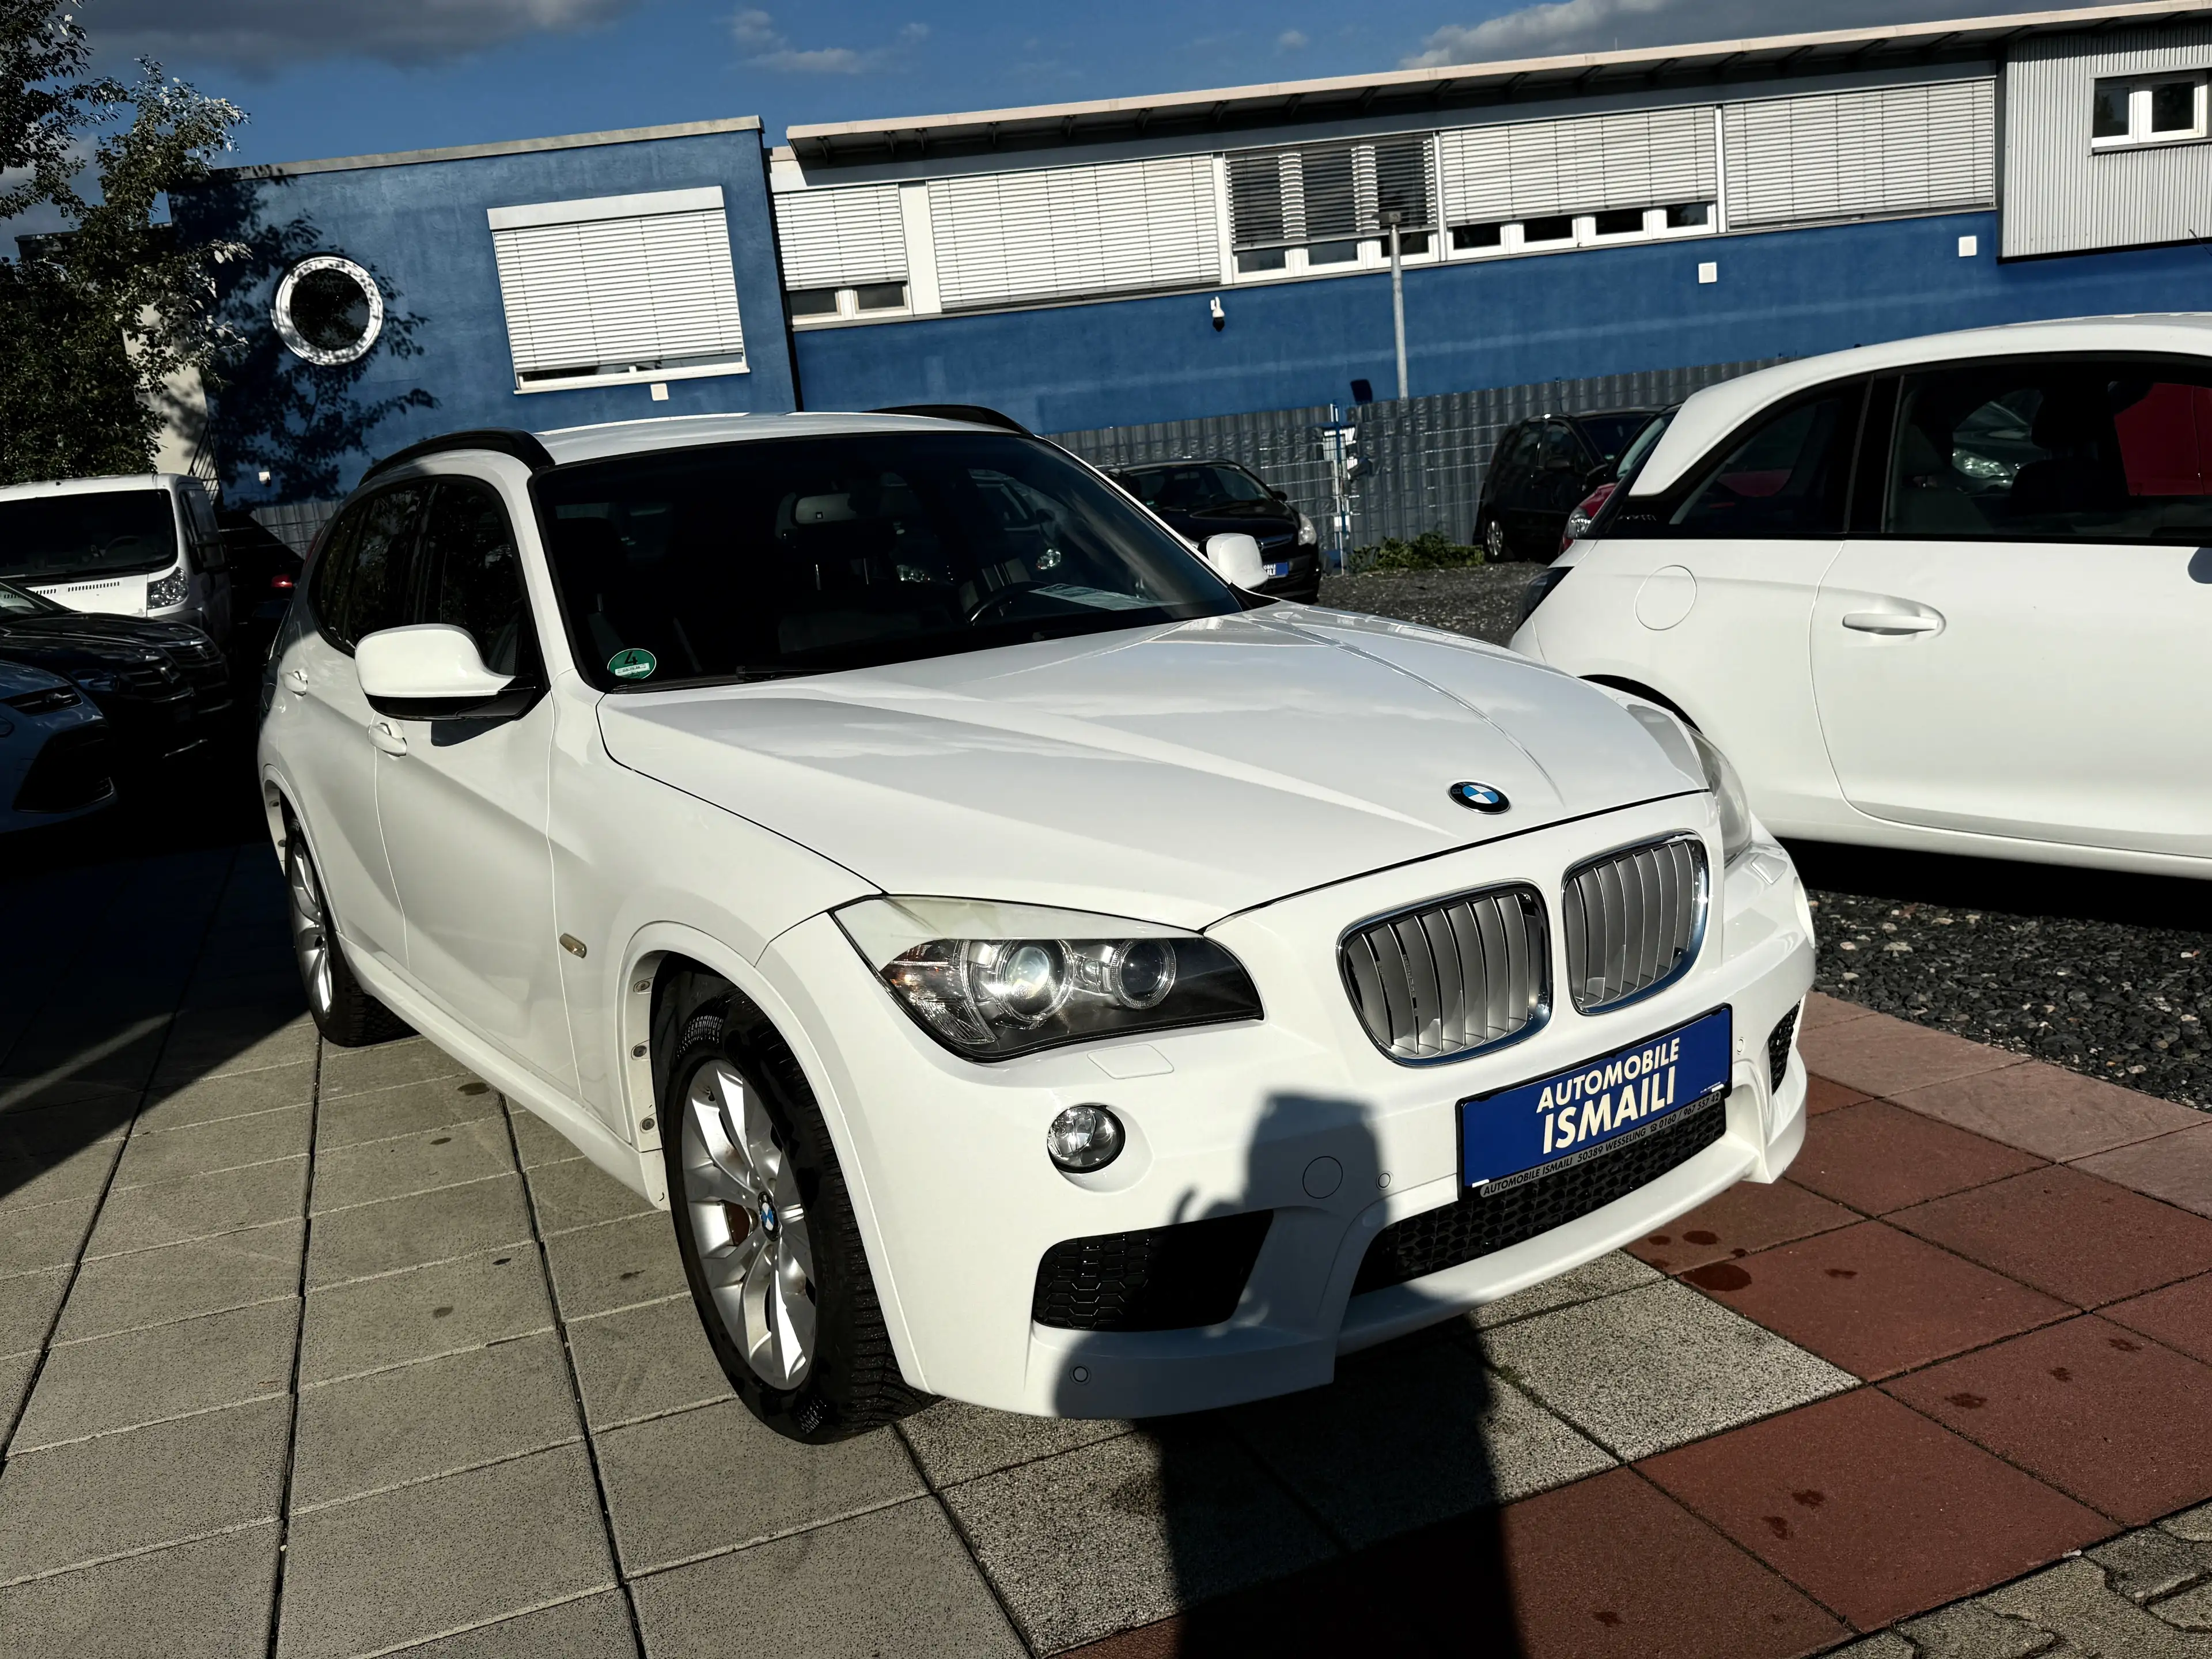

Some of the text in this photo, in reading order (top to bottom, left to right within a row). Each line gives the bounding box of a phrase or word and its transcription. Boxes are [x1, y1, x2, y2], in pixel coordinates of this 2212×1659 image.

[624, 651, 638, 665] 4
[1536, 1037, 1680, 1113] AUTOMOBILE
[1543, 1066, 1676, 1154] ISMAILI
[1483, 1169, 1540, 1195] AUTOMOBILE
[1542, 1157, 1573, 1175] ISMAILI
[1577, 1146, 1603, 1162] 50389
[1605, 1128, 1646, 1152] WESSELING
[1659, 1113, 1676, 1128] 0160
[1683, 1105, 1695, 1118] 967
[1697, 1098, 1709, 1111] 557
[1711, 1093, 1719, 1103] 42
